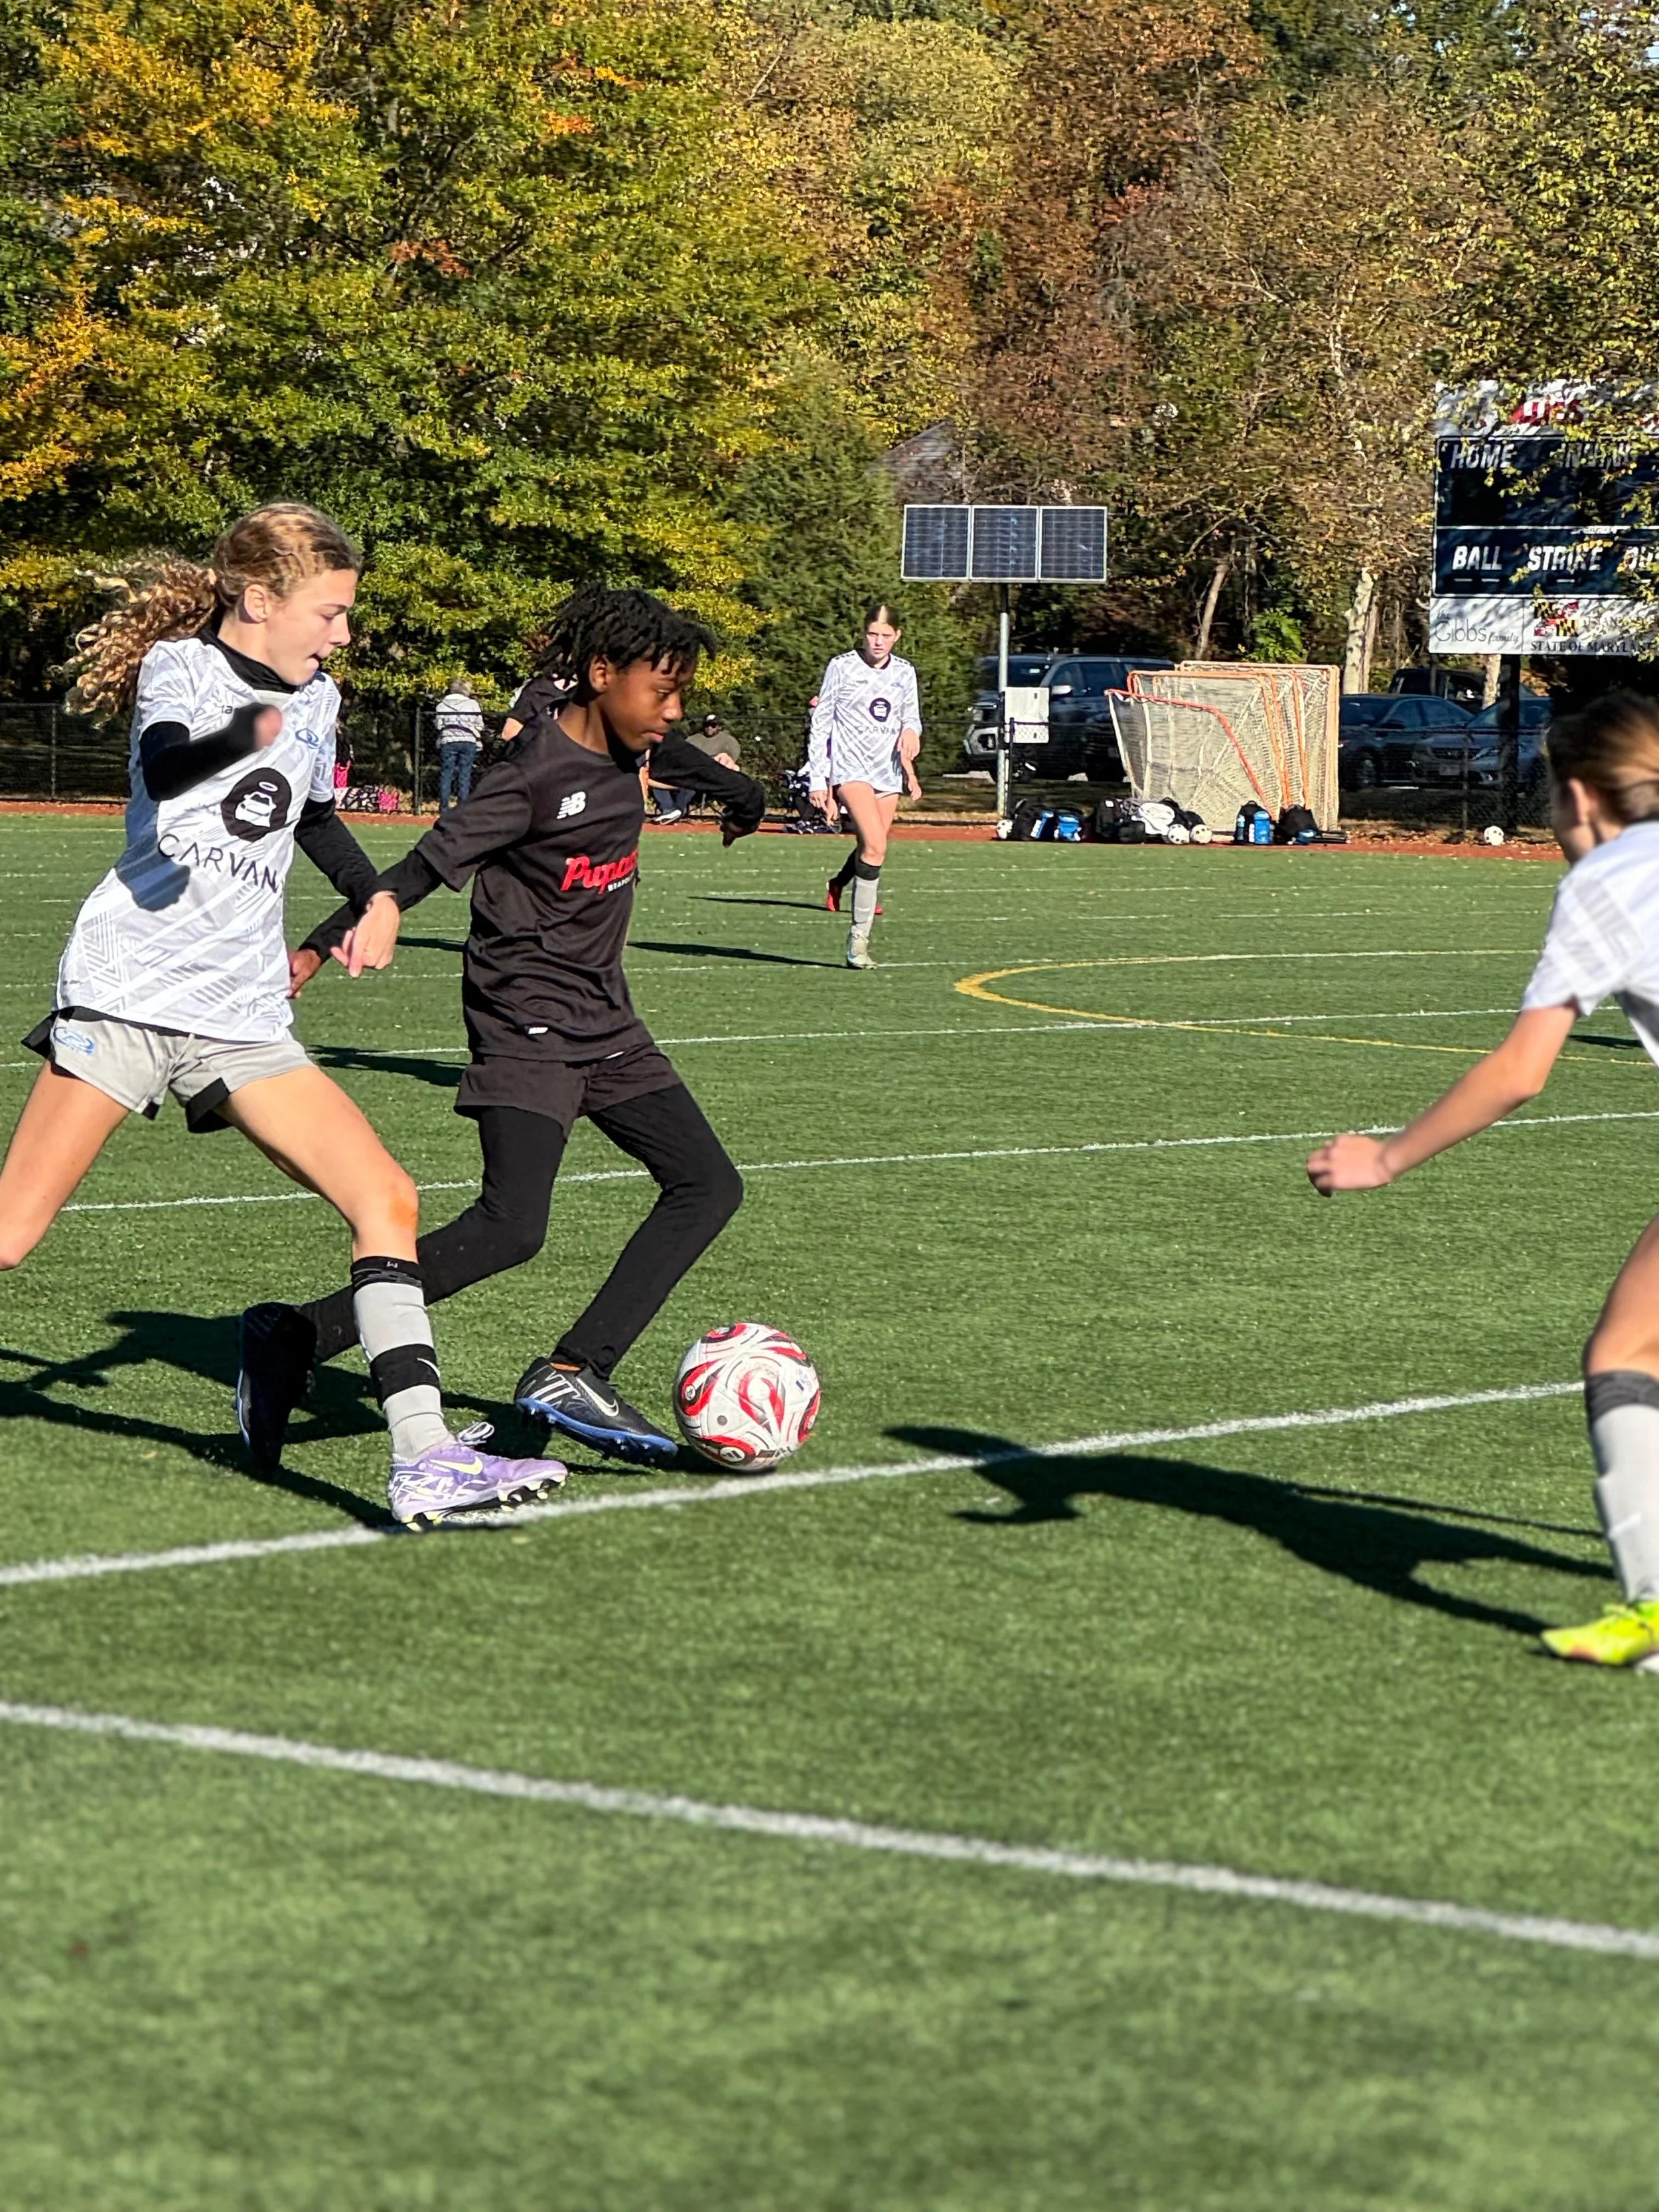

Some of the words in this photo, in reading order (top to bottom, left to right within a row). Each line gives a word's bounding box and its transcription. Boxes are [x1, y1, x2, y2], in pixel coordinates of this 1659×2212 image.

[1450, 443, 1515, 469] HOME
[1452, 546, 1502, 571] BALL
[1435, 618, 1487, 642] Gibbs
[1531, 640, 1566, 652] STATE
